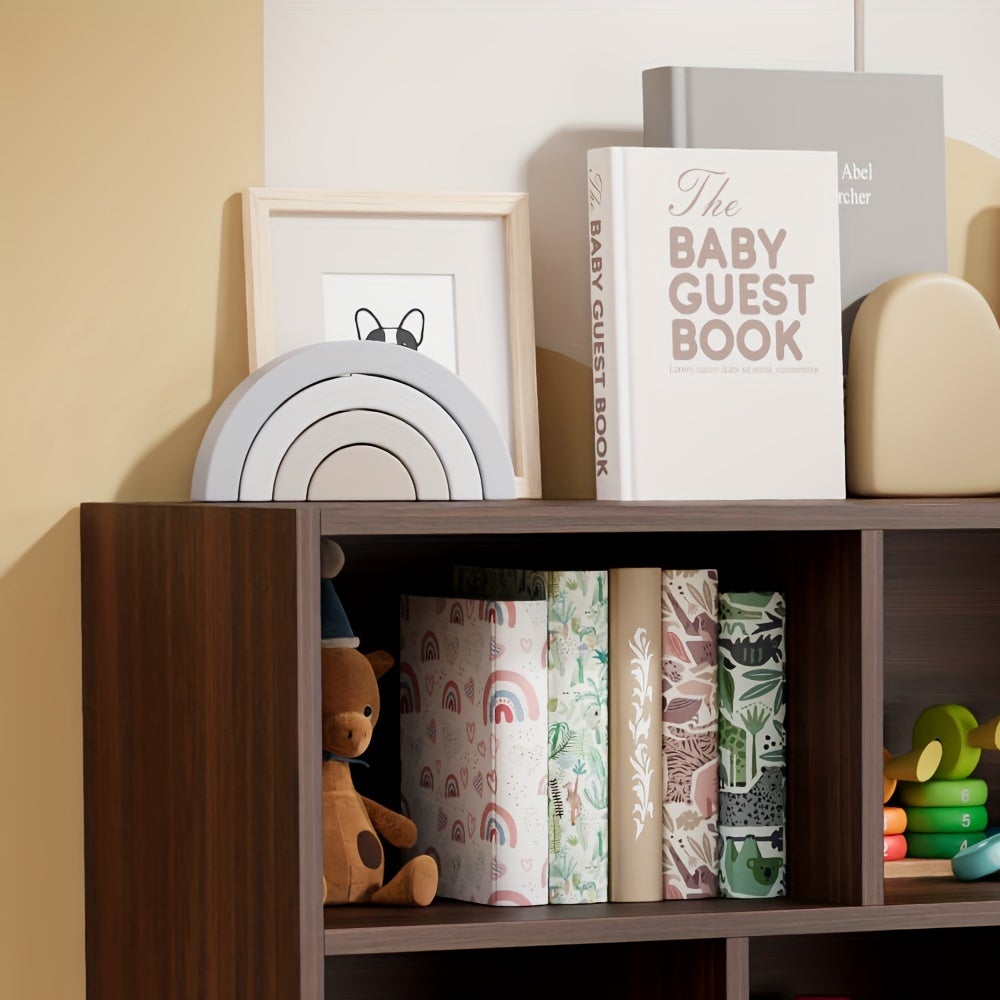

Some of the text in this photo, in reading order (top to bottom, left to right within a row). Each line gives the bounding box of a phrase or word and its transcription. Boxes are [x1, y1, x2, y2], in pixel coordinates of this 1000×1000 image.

[668, 168, 742, 217] The
[841, 162, 873, 181] Abel
[590, 219, 604, 292] BABY
[669, 226, 788, 270] BABY
[668, 272, 816, 316] GUEST
[592, 299, 606, 388] GUEST
[671, 318, 804, 362] BOOK
[595, 397, 609, 478] BOOK
[962, 813, 971, 828] 5
